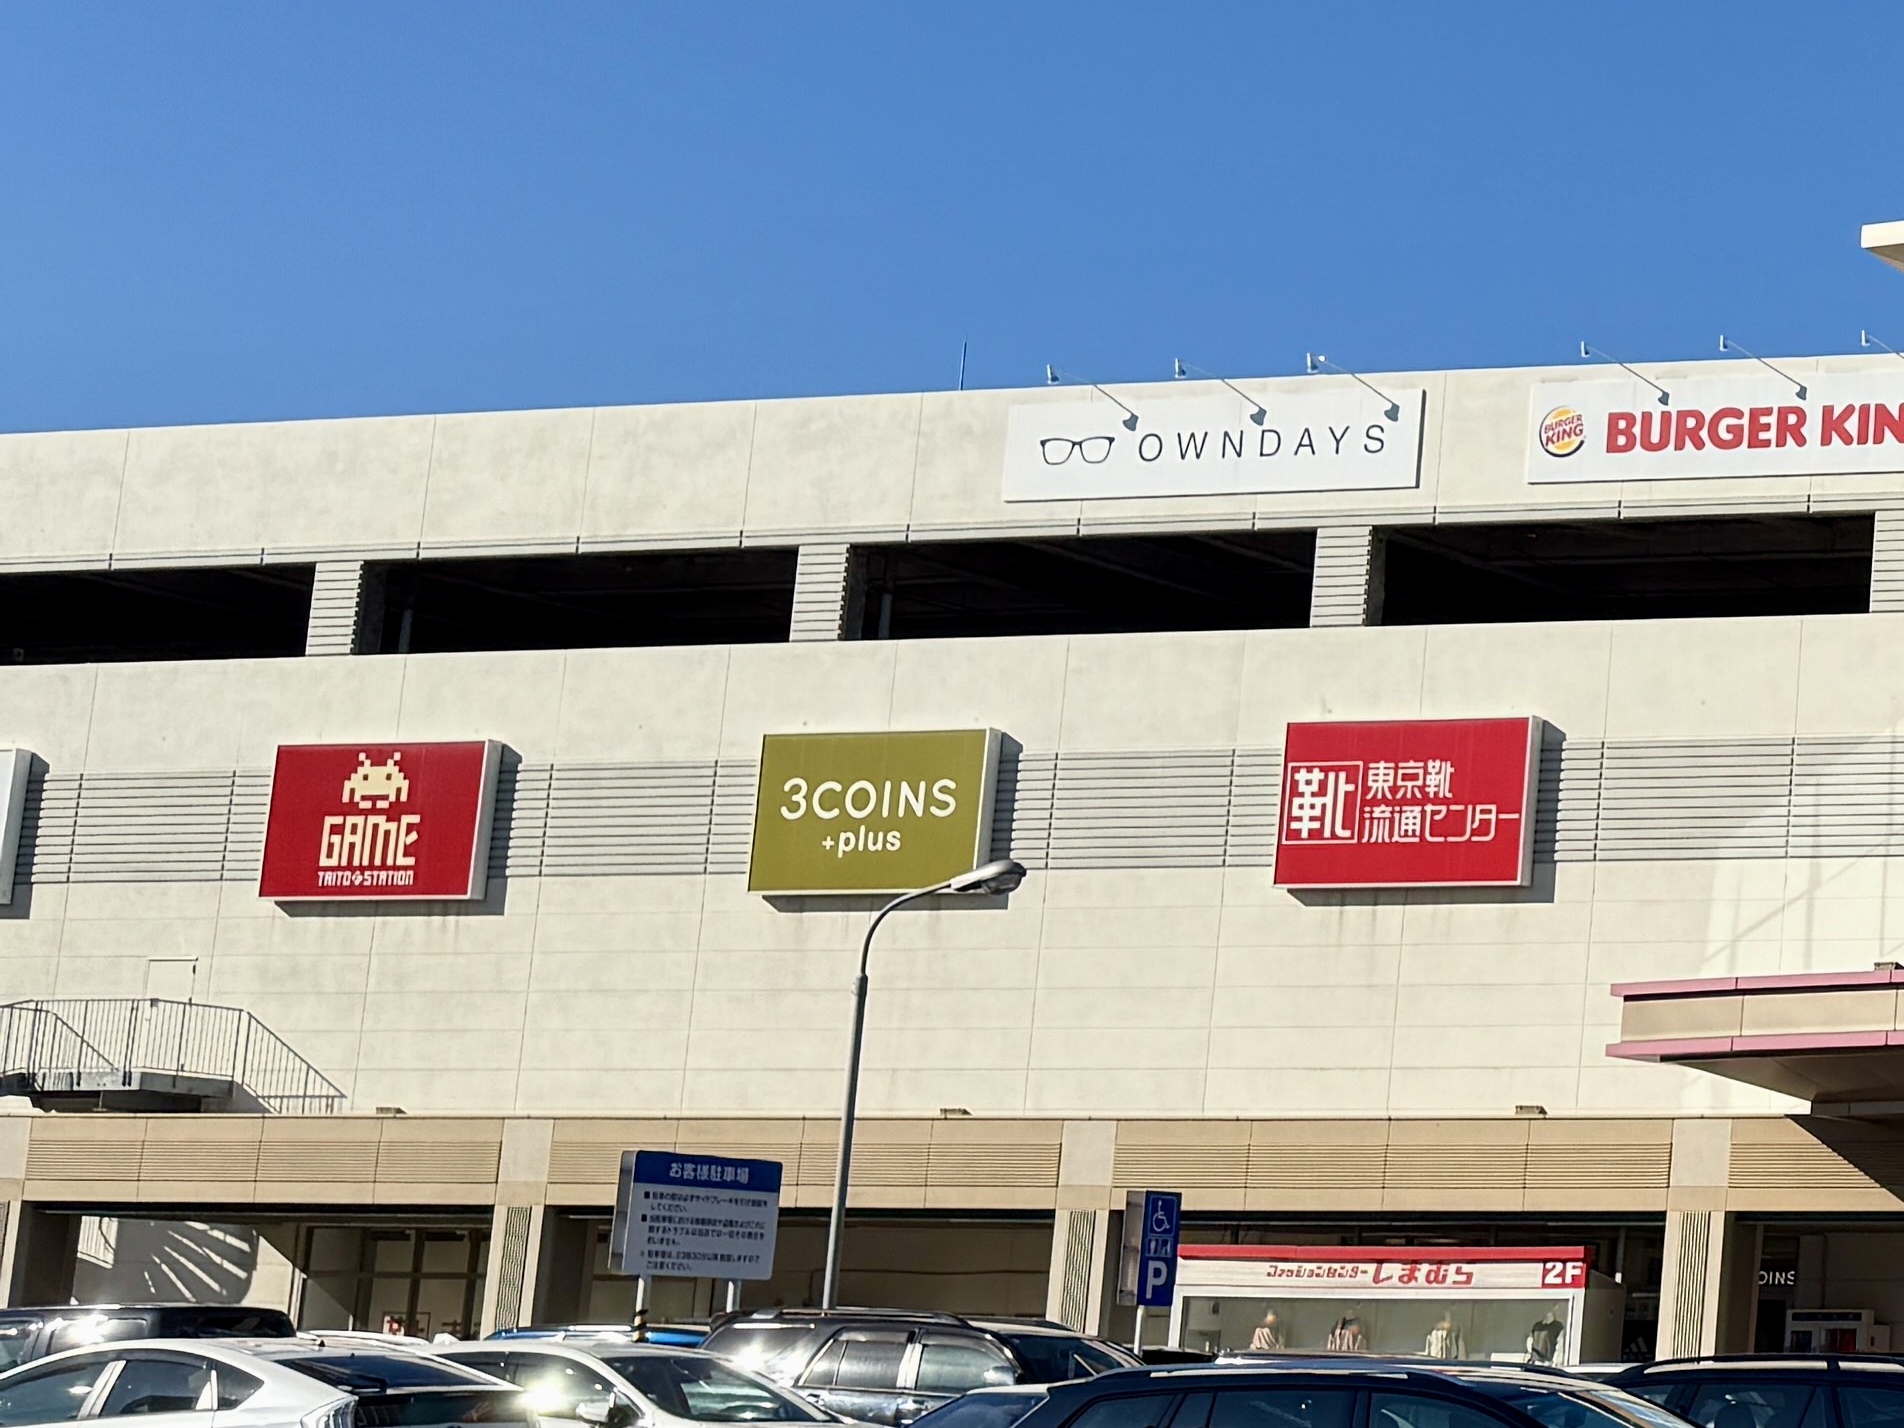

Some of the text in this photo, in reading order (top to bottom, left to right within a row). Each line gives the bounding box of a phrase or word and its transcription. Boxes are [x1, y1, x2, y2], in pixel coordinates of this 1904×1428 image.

[1138, 424, 1386, 462] OWNDAYS
[1543, 413, 1583, 434] BURGER
[1545, 422, 1584, 447] KING
[1605, 406, 1808, 454] BURGER
[779, 776, 958, 821] 3COINS
[1365, 758, 1456, 801] 東京靴
[1290, 767, 1356, 839] 靴
[318, 814, 421, 867] GAME
[1361, 803, 1521, 844] 流通センター
[317, 870, 415, 888] TAITO STATION
[669, 1162, 750, 1184] お客様駐車場
[1145, 1260, 1168, 1300] P
[1543, 1261, 1585, 1284] 2F
